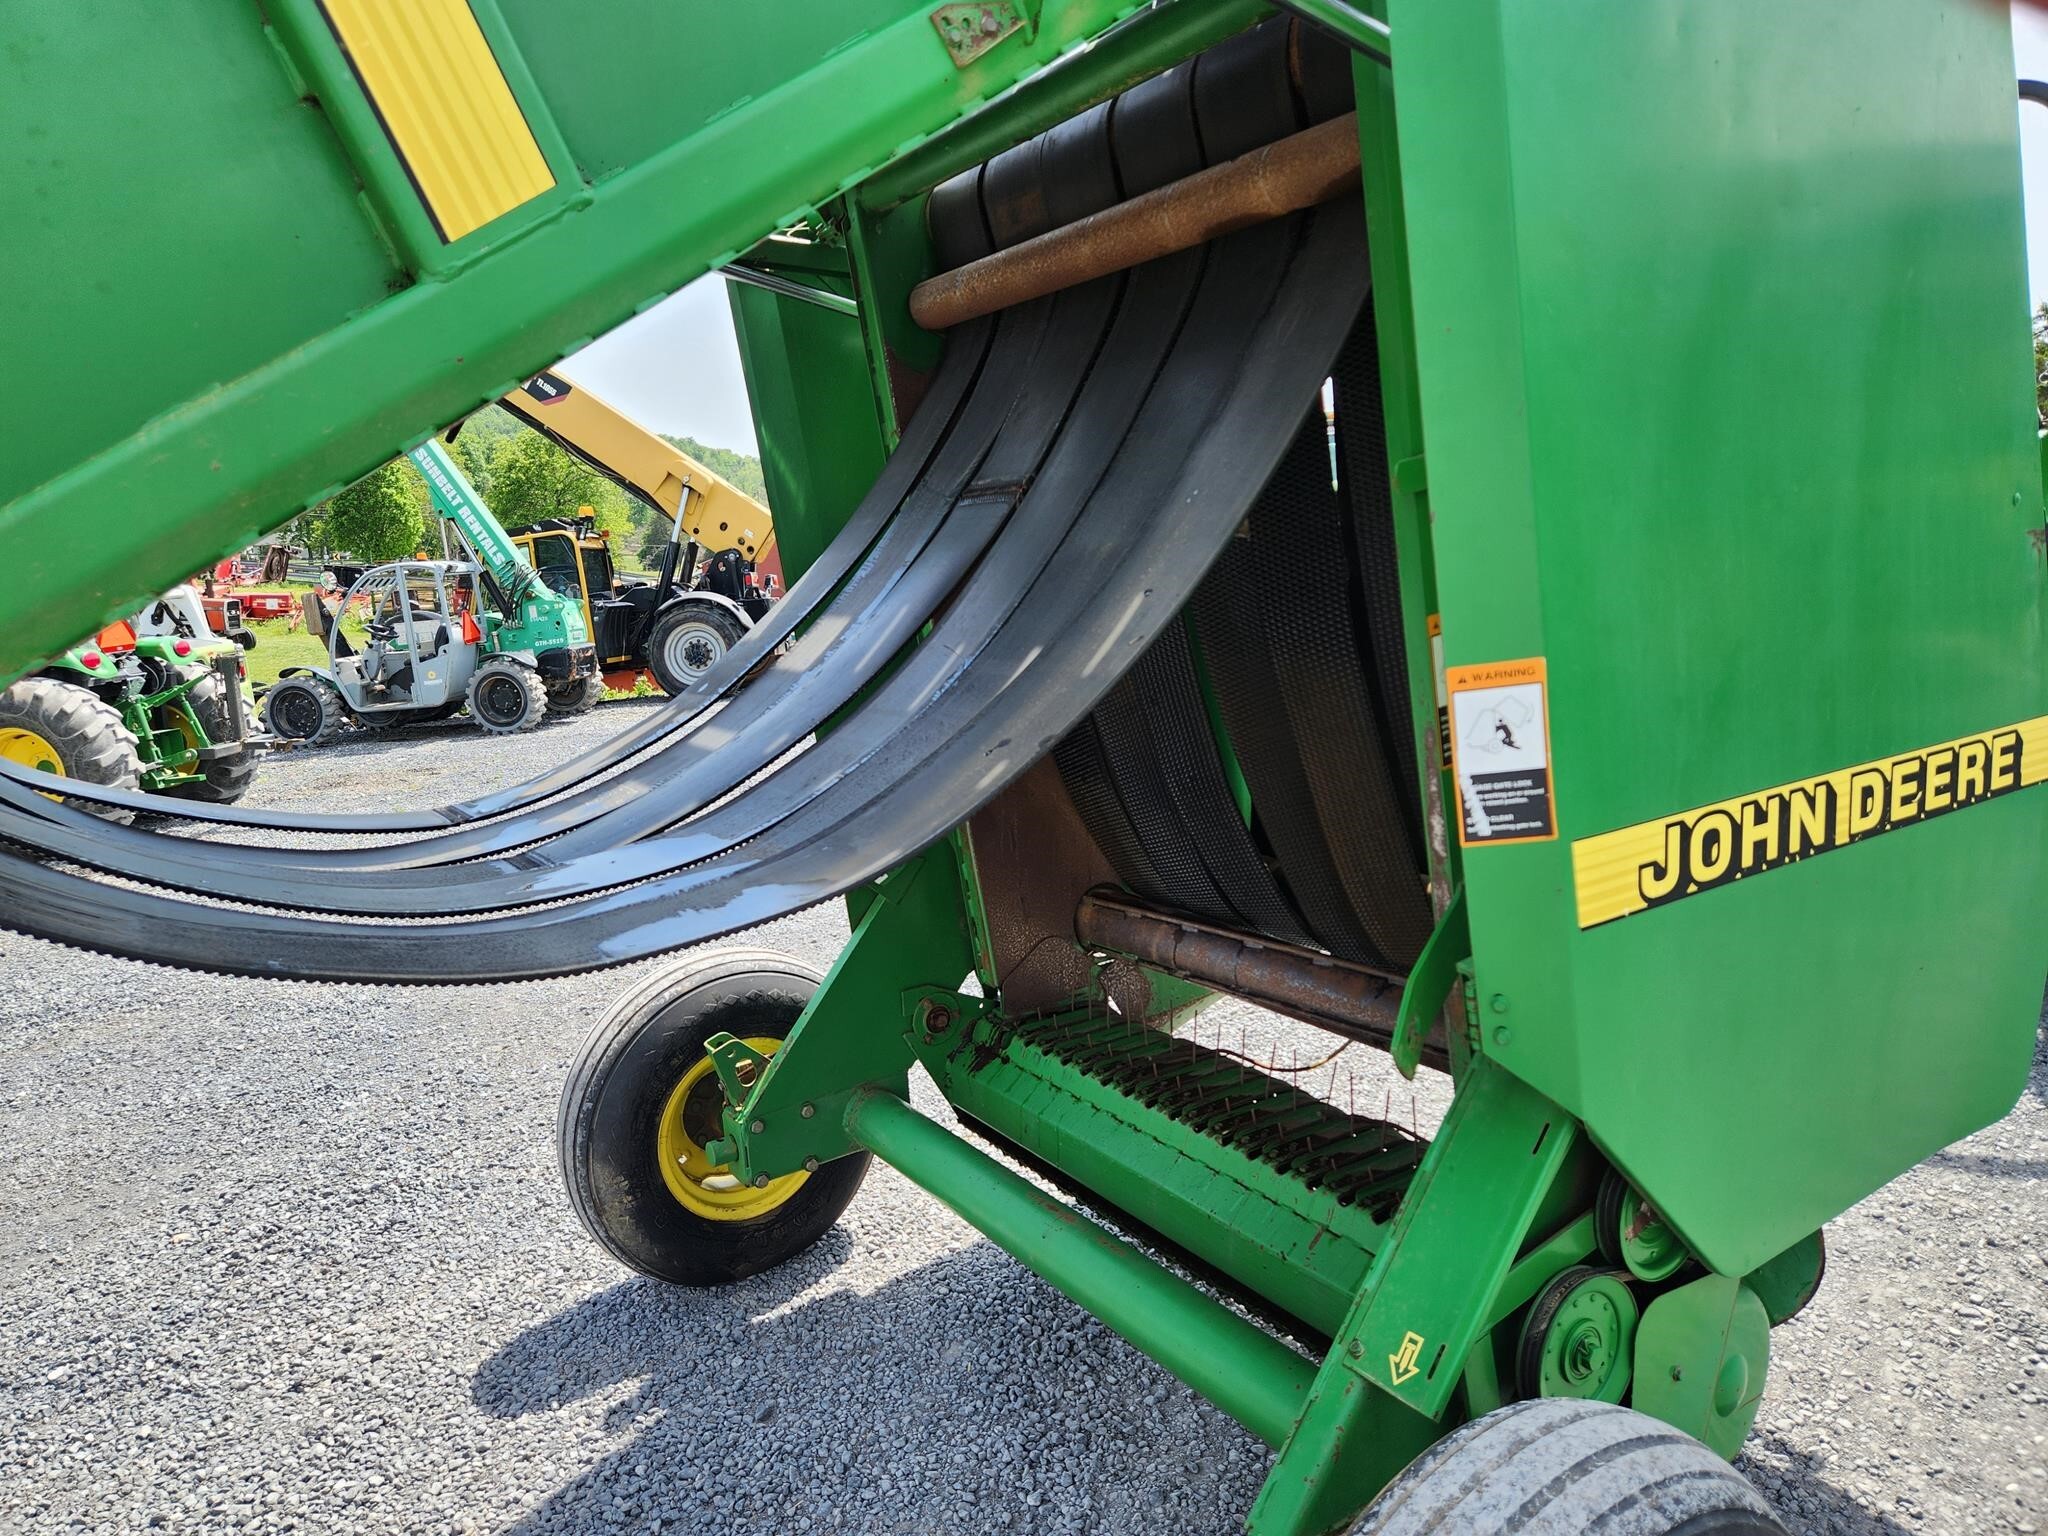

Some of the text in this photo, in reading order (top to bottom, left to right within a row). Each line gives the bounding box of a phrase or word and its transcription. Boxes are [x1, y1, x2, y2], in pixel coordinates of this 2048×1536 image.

[414, 447, 506, 566] SUNBELT RENTALS
[1472, 666, 1536, 682] WARNING
[1638, 730, 2024, 904] JOHN DEERE
